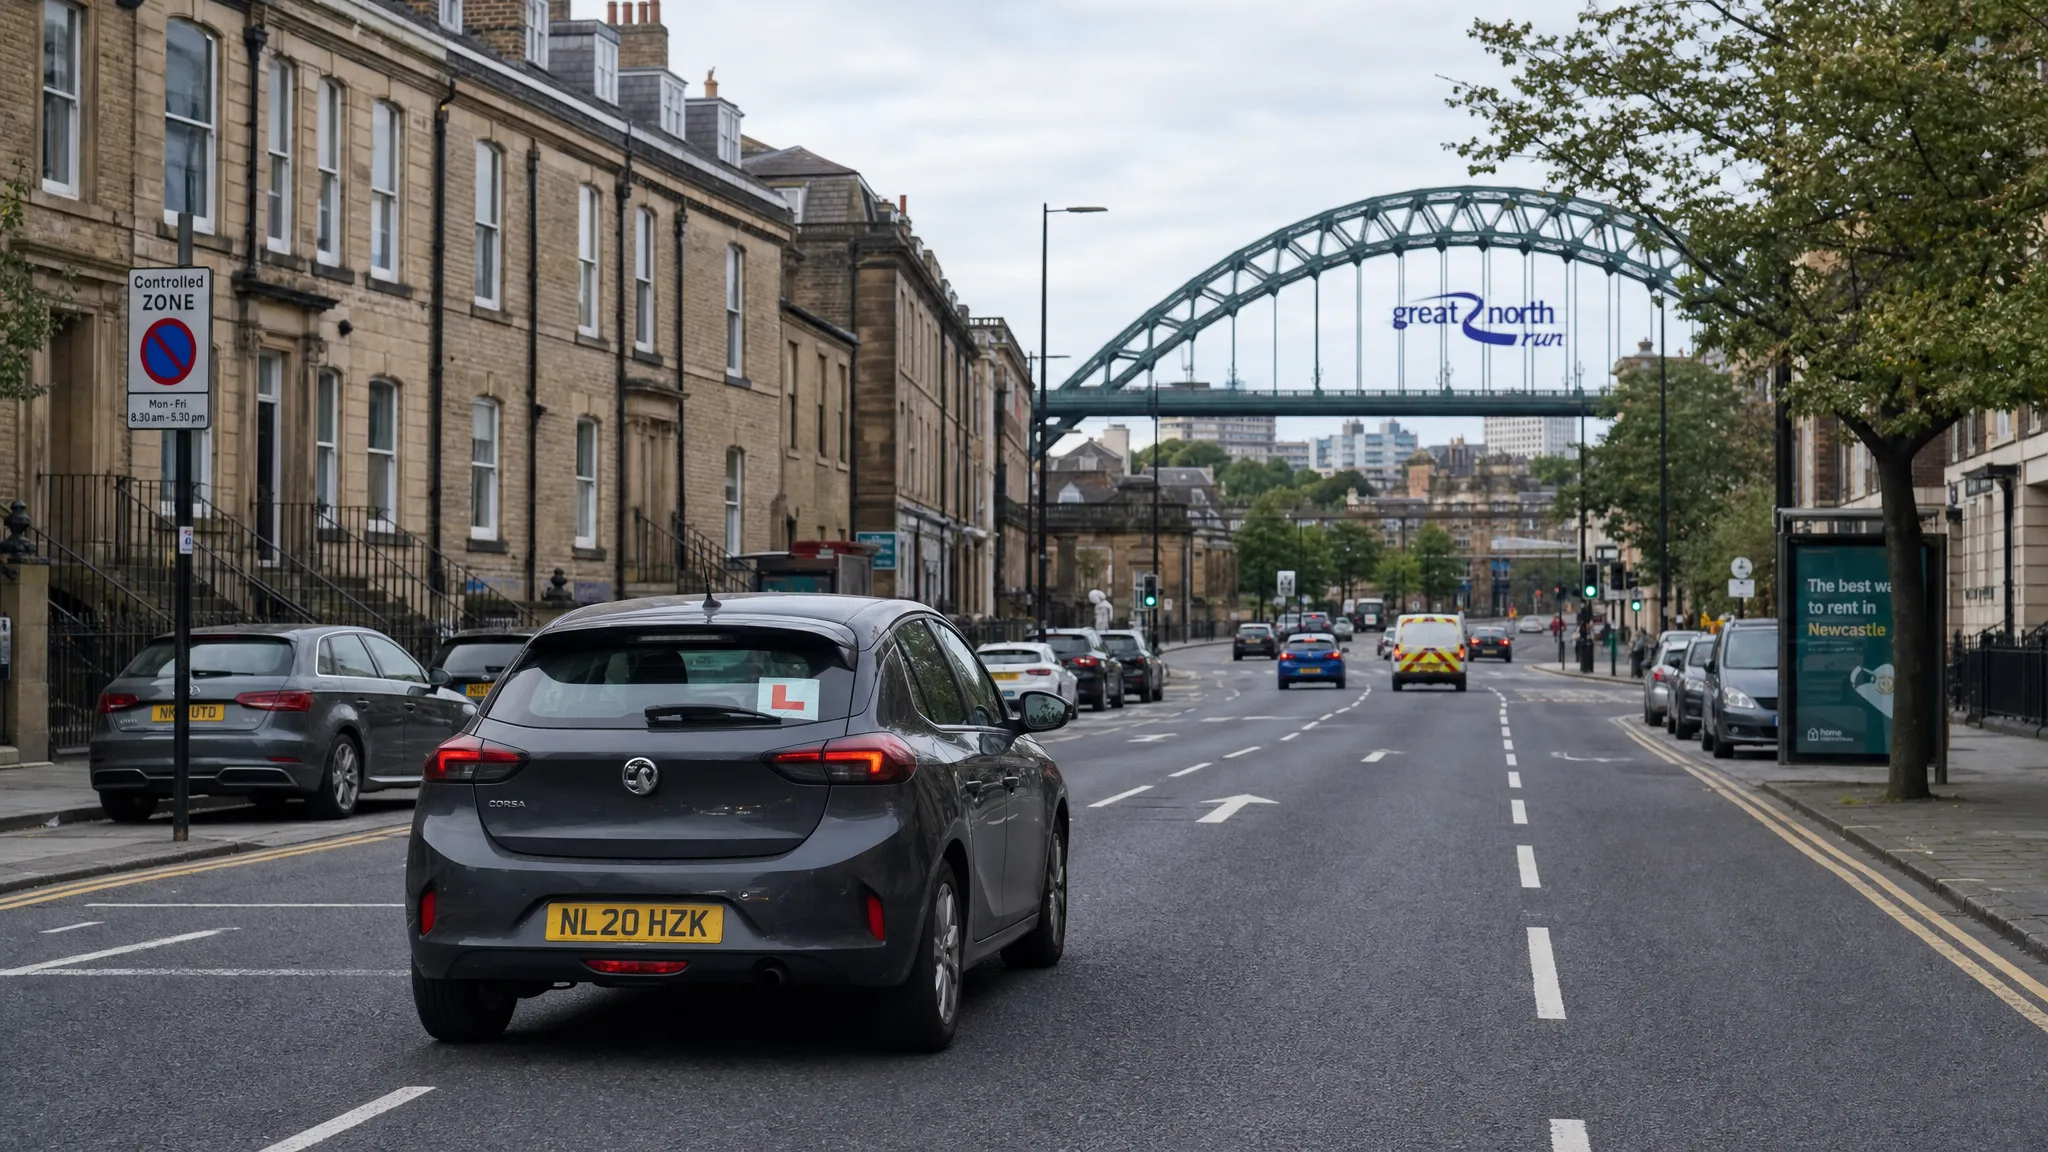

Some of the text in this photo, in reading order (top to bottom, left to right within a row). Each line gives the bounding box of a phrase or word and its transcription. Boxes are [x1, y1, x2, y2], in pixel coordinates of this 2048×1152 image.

[134, 275, 204, 289] Controlled
[142, 294, 195, 311] ZONE
[1393, 300, 1554, 330] great north
[1521, 333, 1563, 347] run
[149, 399, 168, 409] Mon
[175, 399, 187, 408] Fri
[131, 412, 150, 422] 8.30
[151, 414, 165, 422] am
[171, 412, 190, 422] 5.30
[191, 414, 205, 424] pm
[1807, 578, 1892, 593] The best wa
[1808, 599, 1877, 615] to rent in
[1808, 622, 1886, 637] Newcastle
[771, 684, 805, 711] L
[191, 706, 217, 718] UTD
[1820, 728, 1842, 737] home
[488, 799, 526, 808] CORSA
[559, 908, 709, 938] NL20 HZK
